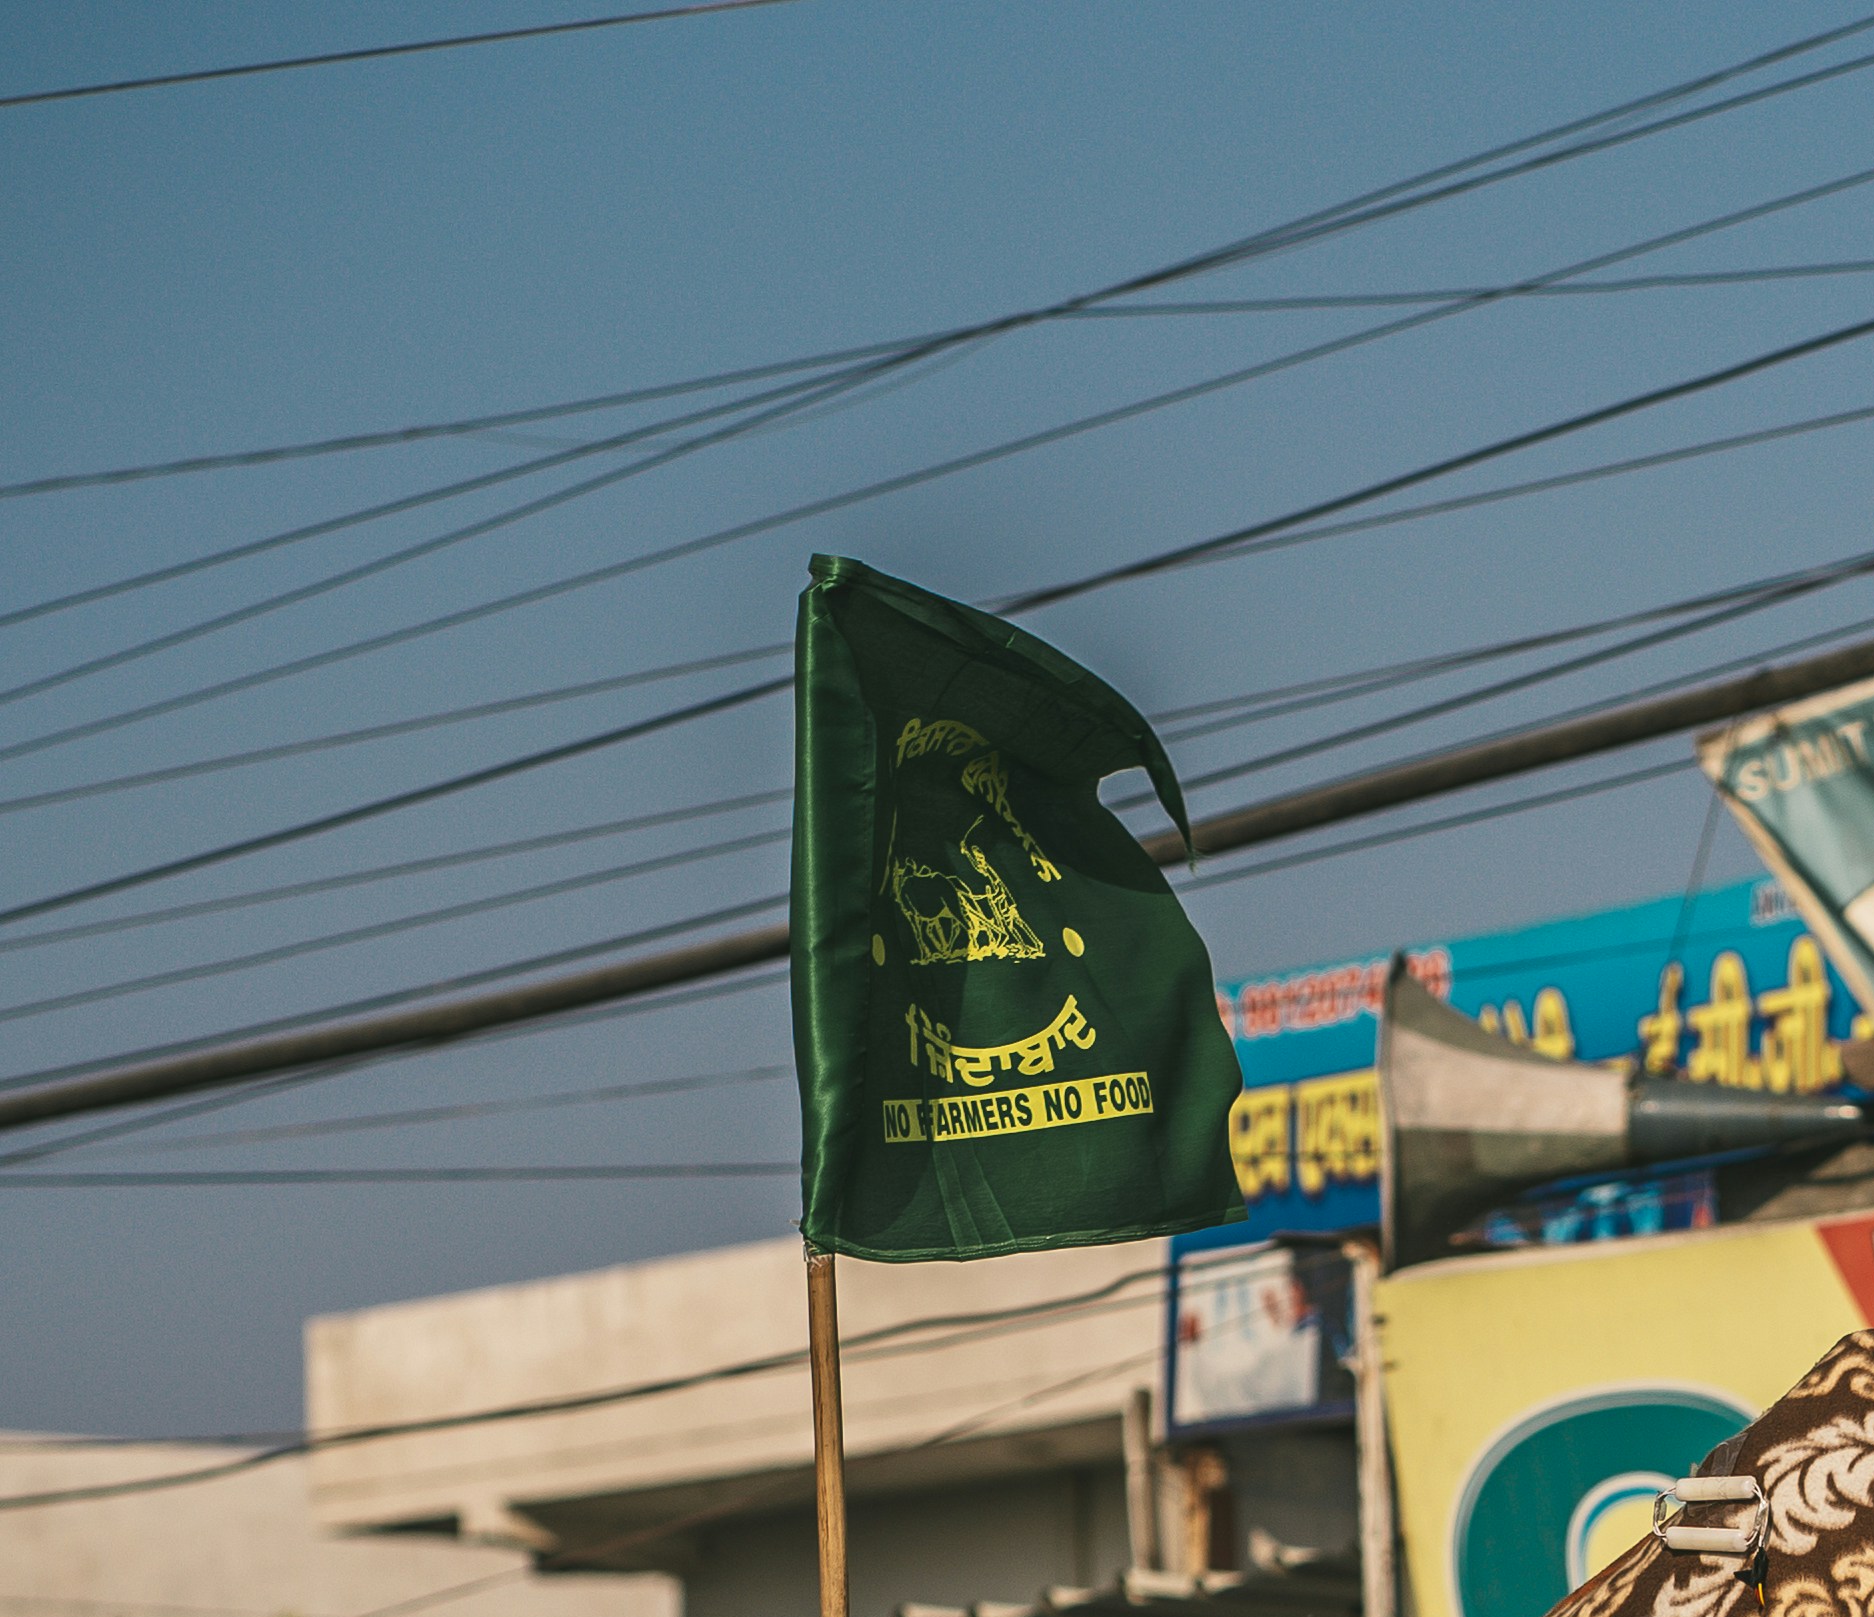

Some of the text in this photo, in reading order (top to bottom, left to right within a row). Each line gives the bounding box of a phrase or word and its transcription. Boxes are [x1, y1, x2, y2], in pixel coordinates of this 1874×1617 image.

[1734, 723, 1871, 803] SUMIT
[885, 1075, 1150, 1139] NO FARMERS NO FOOD
